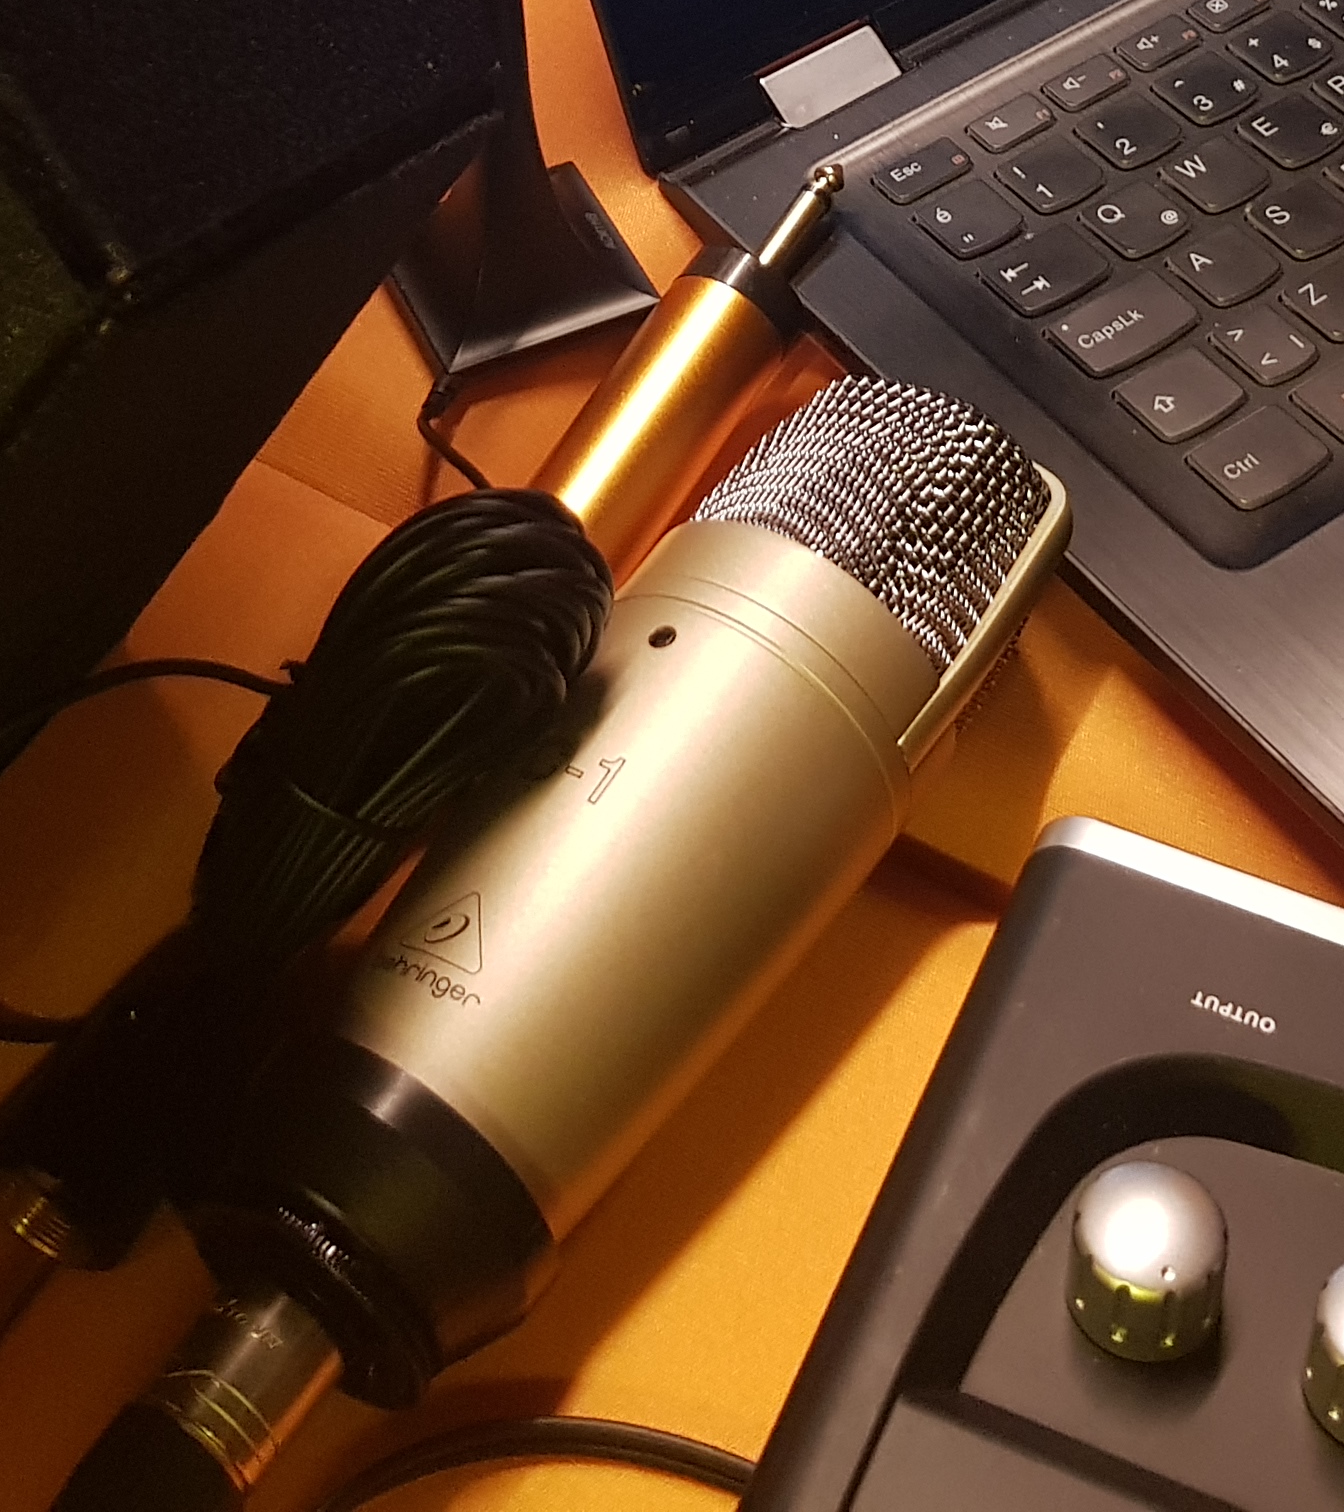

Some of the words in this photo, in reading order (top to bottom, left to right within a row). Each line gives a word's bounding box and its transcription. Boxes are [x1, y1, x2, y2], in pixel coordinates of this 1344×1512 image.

[1252, 116, 1279, 138] E
[890, 161, 922, 183] Esc
[1175, 155, 1207, 179] W
[1097, 204, 1126, 223] Q
[1265, 206, 1291, 225] S
[1188, 252, 1213, 272] A
[1298, 283, 1328, 307] Z
[1077, 308, 1145, 350] CapsLk
[1223, 453, 1260, 480] Ctrl
[1190, 990, 1276, 1034] OUTPUT
